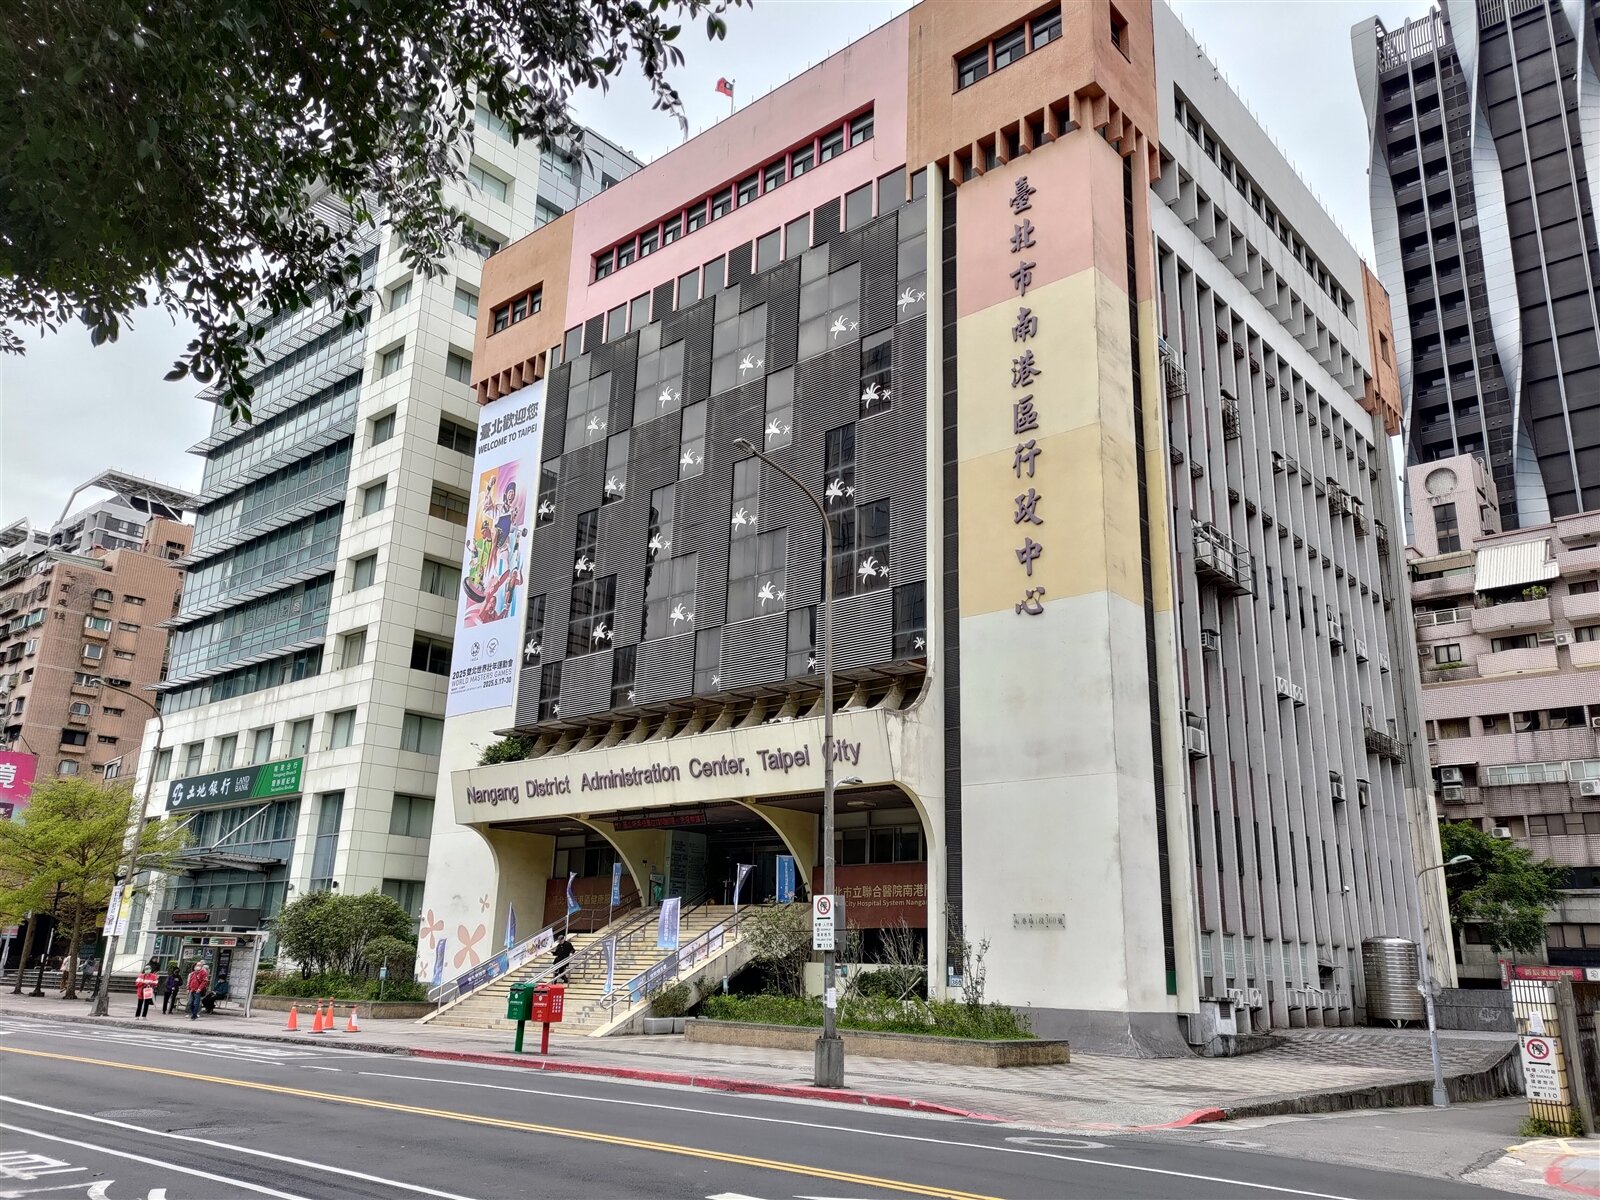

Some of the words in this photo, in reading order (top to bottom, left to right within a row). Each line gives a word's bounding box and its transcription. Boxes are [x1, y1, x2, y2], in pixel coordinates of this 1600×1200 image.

[1010, 176, 1045, 616] 臺北市南港區行政中心
[480, 402, 539, 441] 臺北歡迎您
[478, 437, 507, 454] WELCOME
[509, 432, 516, 443] TO
[518, 423, 537, 439] TAIPEI
[451, 677, 468, 687] WORLD
[470, 671, 493, 683] MASTERS
[494, 668, 512, 678] GAMES
[236, 775, 250, 785] LAND
[467, 785, 519, 806] Nangang
[526, 775, 571, 798] District
[581, 763, 680, 792] Administration
[689, 754, 750, 778] Center,
[756, 744, 810, 774] Taipei
[186, 777, 231, 800] 土地銀行
[234, 784, 249, 793] BANK
[857, 900, 881, 908] Hospital
[883, 899, 905, 908] System
